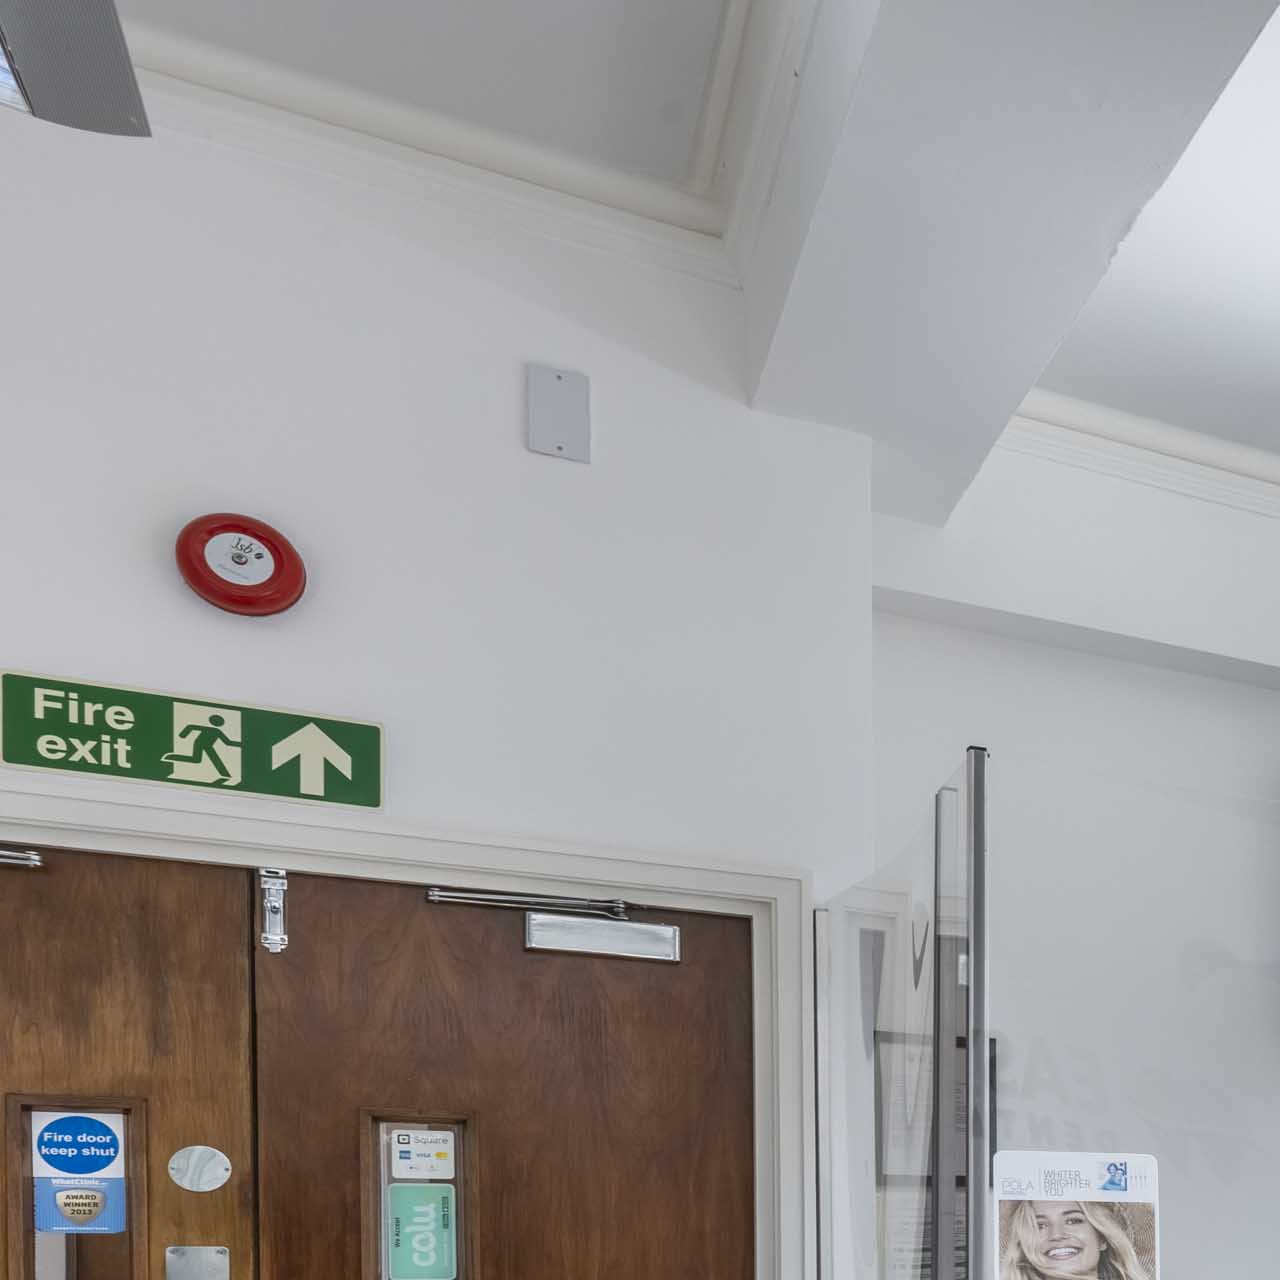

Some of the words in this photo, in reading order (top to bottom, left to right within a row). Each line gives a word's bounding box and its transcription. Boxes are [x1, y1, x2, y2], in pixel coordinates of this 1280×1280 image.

[34, 687, 135, 730] Fire
[36, 734, 131, 768] exit
[43, 1132, 73, 1142] Fire
[77, 1133, 112, 1143] door
[414, 1135, 449, 1145] Square
[41, 1146, 77, 1157] keep
[82, 1146, 115, 1156] shut
[1043, 1170, 1080, 1179] WHITER
[1043, 1179, 1090, 1190] BRIGHTER
